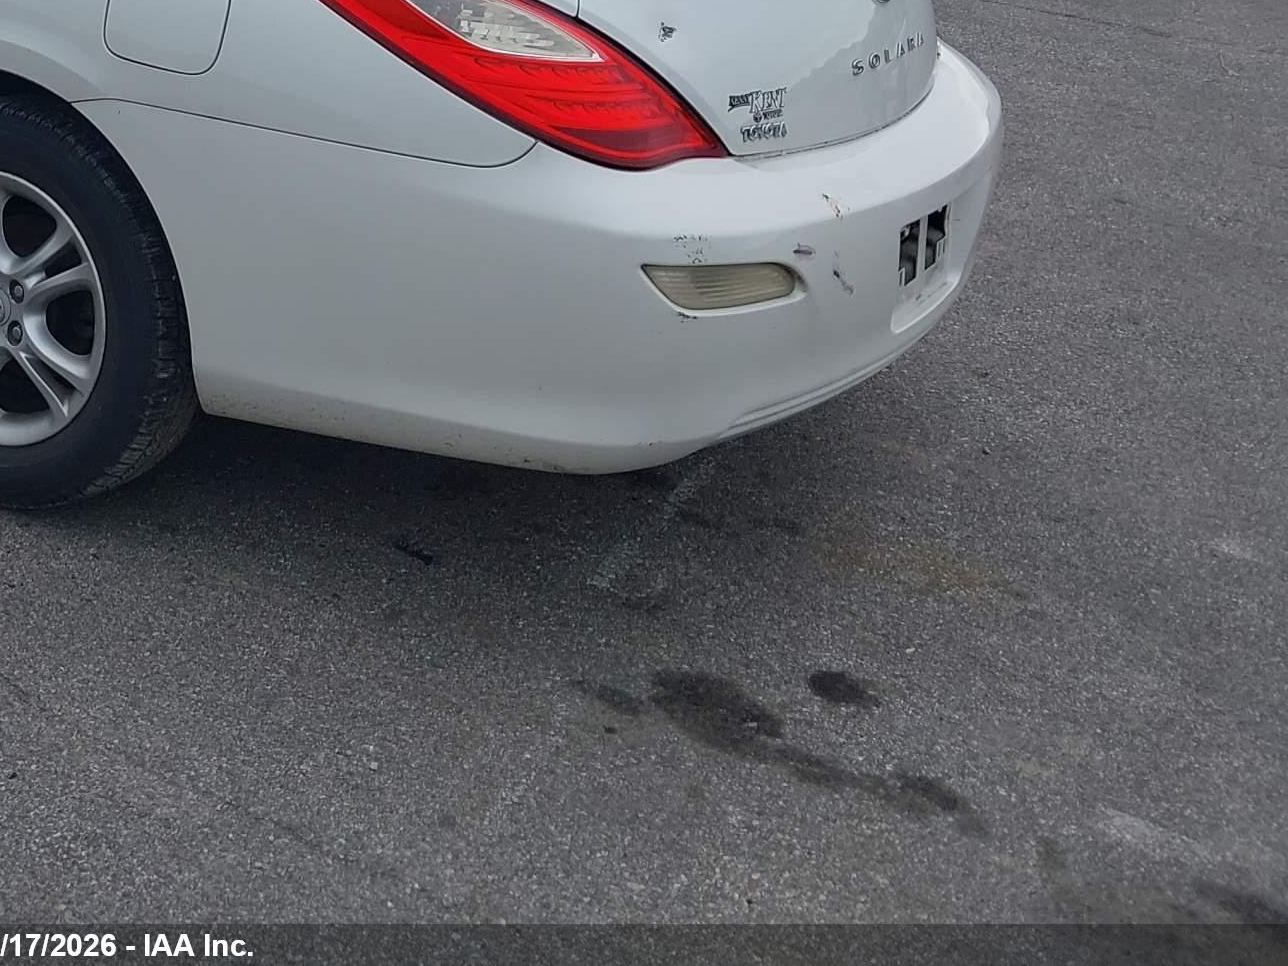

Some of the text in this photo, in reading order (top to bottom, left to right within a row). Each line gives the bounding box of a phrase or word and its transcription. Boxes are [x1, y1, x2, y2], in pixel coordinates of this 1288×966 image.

[851, 32, 925, 76] SOLARA
[749, 87, 787, 114] KENT
[740, 122, 788, 142] TOYOTA
